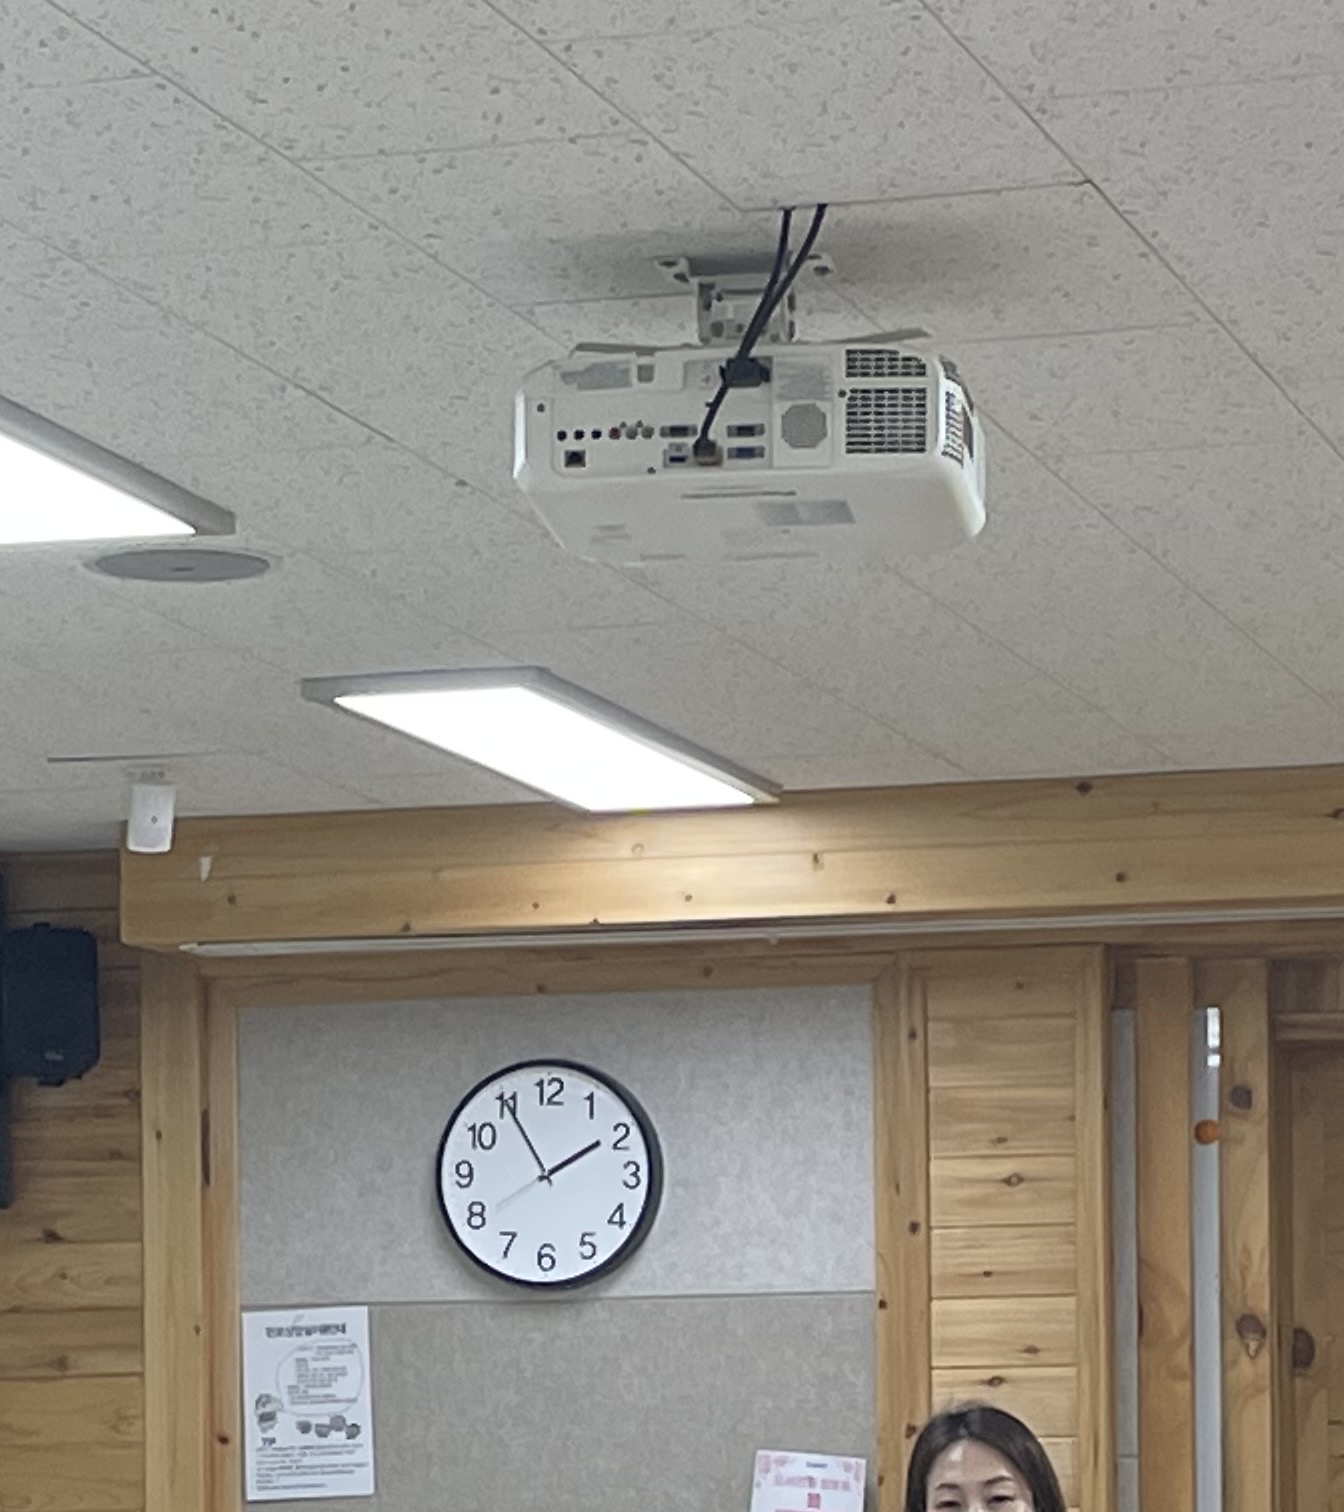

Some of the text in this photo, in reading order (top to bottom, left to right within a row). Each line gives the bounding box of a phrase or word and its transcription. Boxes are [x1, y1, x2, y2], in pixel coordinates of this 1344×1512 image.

[495, 1091, 518, 1119] 11
[534, 1077, 565, 1106] 12
[583, 1091, 594, 1120] 1
[467, 1122, 497, 1150] 10
[612, 1122, 630, 1151] 2
[455, 1160, 474, 1188] 9
[622, 1161, 641, 1190] 3
[467, 1201, 486, 1230] 8
[607, 1203, 626, 1230] 4
[499, 1231, 518, 1259] 7
[537, 1243, 556, 1272] 6
[578, 1232, 597, 1260] 5
